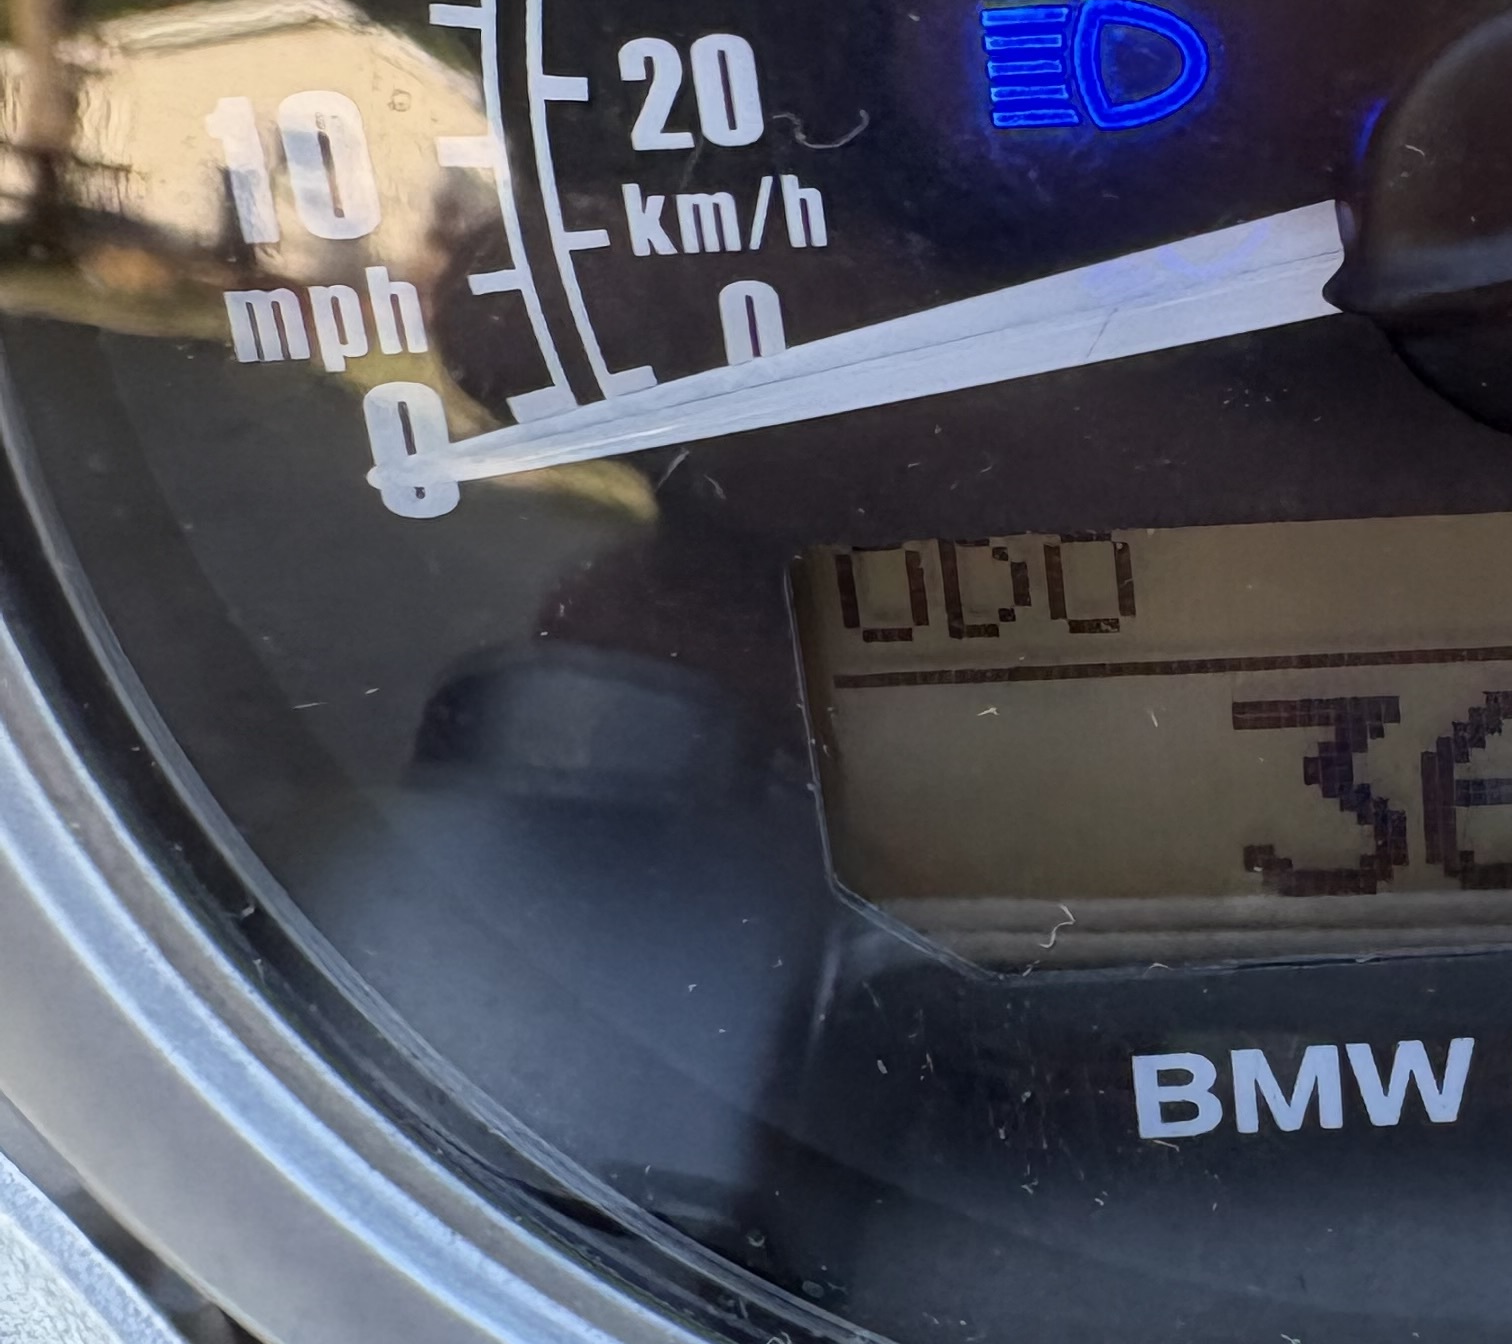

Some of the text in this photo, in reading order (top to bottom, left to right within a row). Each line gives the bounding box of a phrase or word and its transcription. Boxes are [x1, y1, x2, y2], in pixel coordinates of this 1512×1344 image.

[619, 34, 763, 151] 20
[205, 90, 381, 245] 10
[622, 175, 827, 257] km/h
[225, 266, 427, 372] mph
[363, 382, 459, 518] 0
[835, 532, 1136, 642] ODO
[1132, 1035, 1475, 1140] BMW
